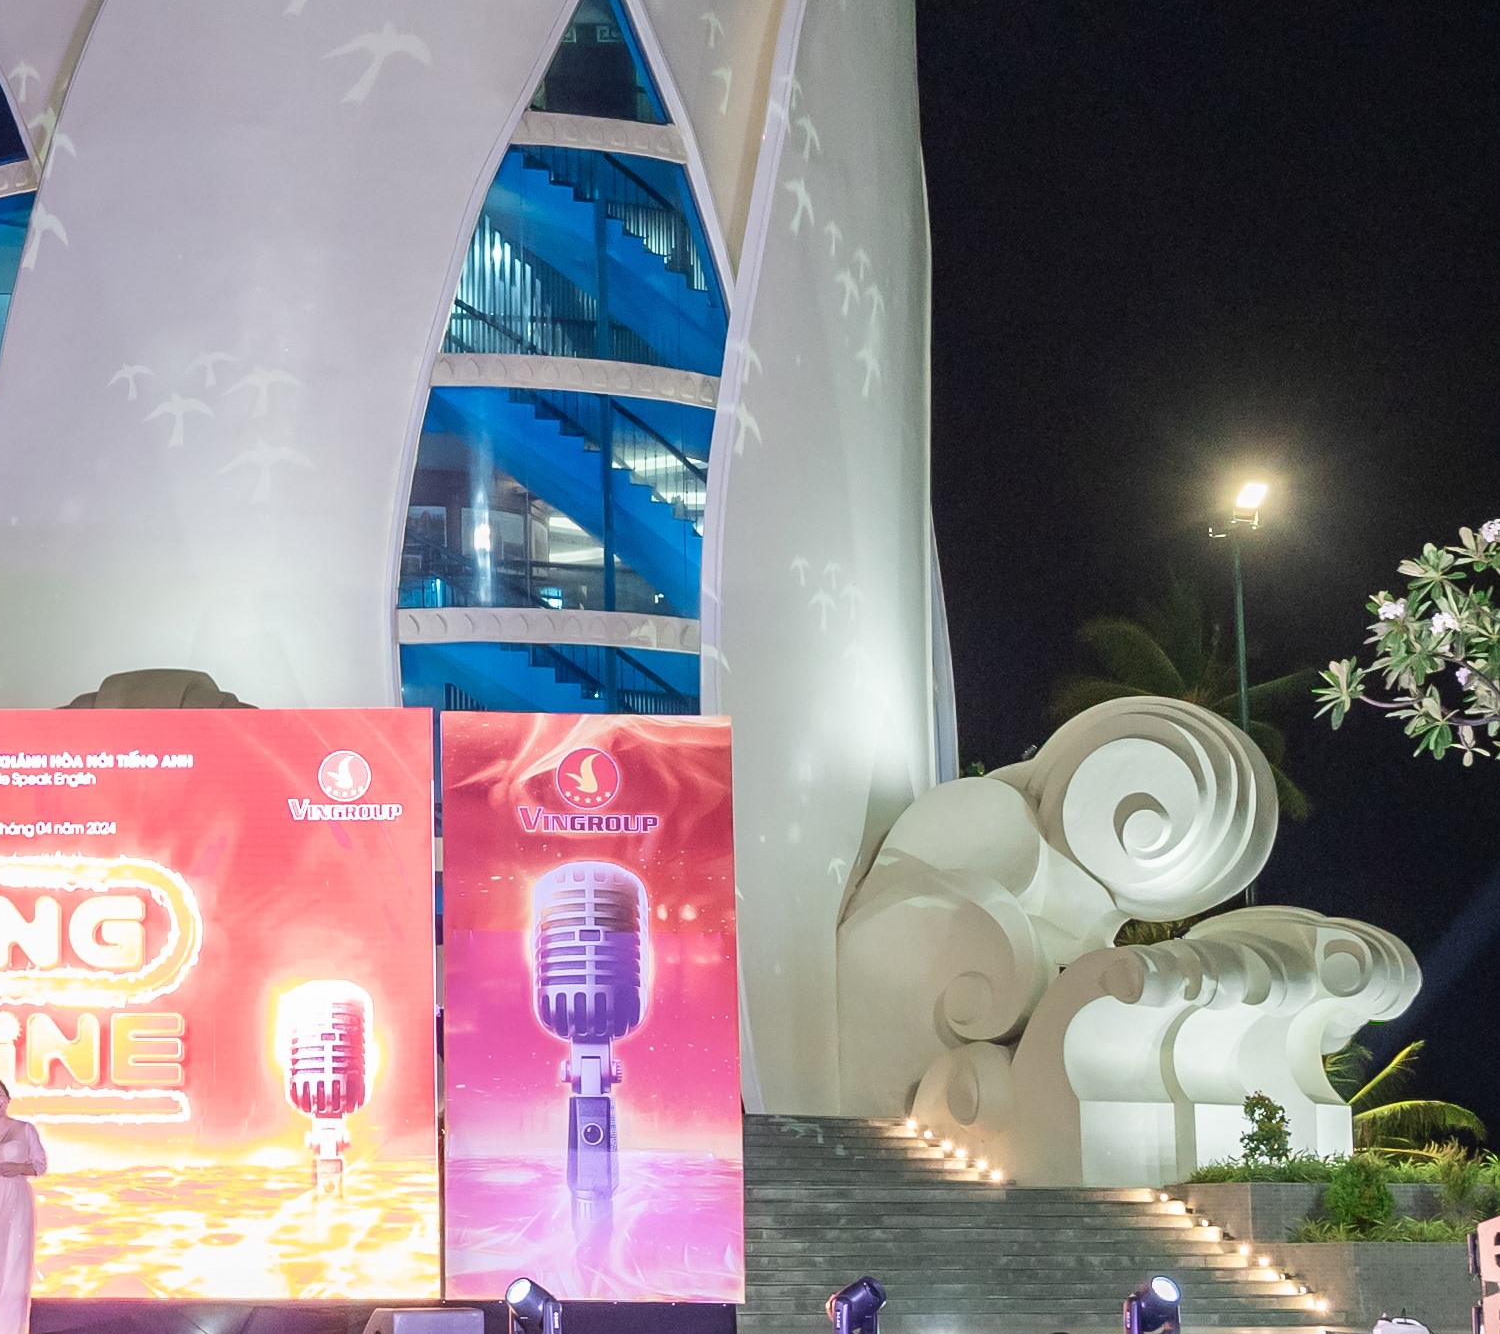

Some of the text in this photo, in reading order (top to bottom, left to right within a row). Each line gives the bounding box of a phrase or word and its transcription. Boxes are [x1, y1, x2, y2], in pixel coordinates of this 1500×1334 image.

[161, 753, 193, 769] ANH
[11, 771, 52, 788] Speak
[53, 771, 96, 788] English
[287, 798, 403, 821] VINGROUP
[517, 805, 660, 833] VINGROUP
[36, 822, 52, 836] 04
[53, 822, 84, 836] năm
[85, 822, 117, 836] 2024
